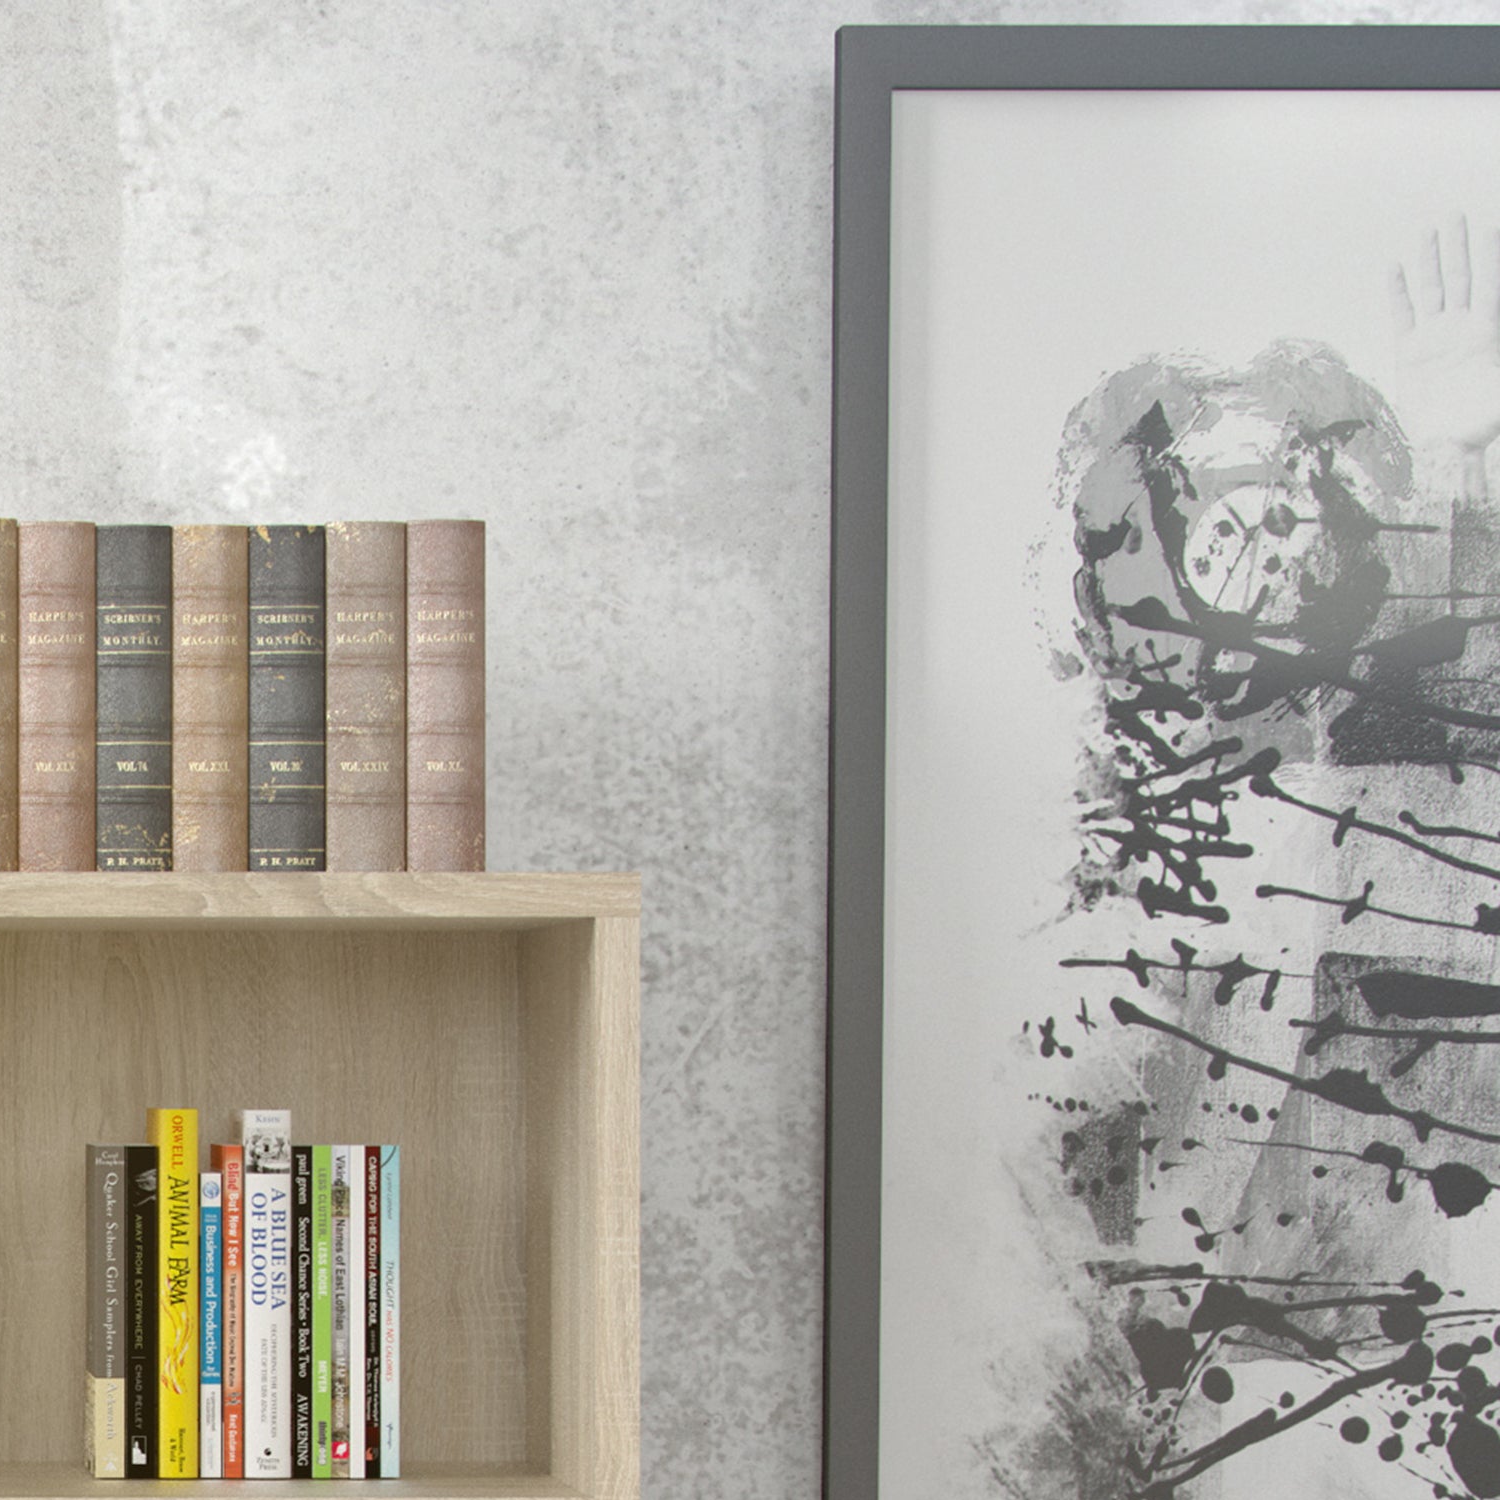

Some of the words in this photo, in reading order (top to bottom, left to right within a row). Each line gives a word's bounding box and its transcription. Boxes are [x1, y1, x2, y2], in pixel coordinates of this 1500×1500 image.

[28, 611, 85, 623] HARPER'S
[103, 613, 162, 625] SCRIBNER'S
[182, 613, 237, 625] HARPER'S
[257, 613, 315, 625] SCRIBNER'S
[336, 611, 394, 623] HARPER'S
[417, 610, 475, 622] HARPER'S
[28, 633, 85, 645] MAGAZINE
[181, 635, 238, 646] MAGAZINE
[336, 633, 395, 645] MAGAZINE
[417, 632, 476, 644] MAGAZINE
[171, 1115, 184, 1169] ORWELL
[227, 1162, 239, 1190] Blind
[296, 1154, 310, 1175] paul
[318, 1167, 327, 1191] LESS
[334, 1154, 346, 1187] Viking
[367, 1156, 377, 1192] CARING
[103, 1172, 119, 1217] Quaker
[227, 1192, 239, 1212] But
[271, 1187, 287, 1203] A
[295, 1177, 308, 1205] green
[335, 1188, 346, 1217] Place
[367, 1194, 377, 1214] FOR
[168, 1175, 191, 1249] ANIMAL
[251, 1192, 268, 1222] OF
[134, 1214, 143, 1243] AWAY
[227, 1215, 239, 1237] Now
[271, 1209, 287, 1267] BLUE
[298, 1217, 310, 1252] Second
[335, 1219, 346, 1253] Names
[367, 1215, 377, 1235] THE
[106, 1222, 119, 1261] School
[205, 1225, 217, 1272] Business
[317, 1241, 328, 1265] LESS
[367, 1237, 377, 1270] SOUTH
[134, 1245, 143, 1274] FROM
[227, 1247, 239, 1267] See
[251, 1227, 268, 1305] BLOOD
[298, 1253, 310, 1290] Chance
[335, 1254, 346, 1266] of
[106, 1266, 119, 1293] Girl
[168, 1257, 191, 1306] FARM
[205, 1276, 217, 1298] and
[271, 1271, 287, 1310] SEA
[335, 1268, 346, 1291] East
[367, 1271, 377, 1300] ASIAN
[386, 1260, 395, 1309] THOUGHT
[134, 1279, 143, 1350] EVERYWHERE
[298, 1291, 310, 1321] Series
[335, 1293, 346, 1331] Lothian
[103, 1298, 119, 1351] Samplers
[205, 1301, 217, 1363] Production
[386, 1328, 395, 1343] NO
[299, 1328, 310, 1353] Book
[106, 1355, 116, 1379] from
[134, 1364, 143, 1393] CHAD
[299, 1354, 310, 1378] Two
[317, 1359, 328, 1393] MEYER
[106, 1382, 119, 1440] Ackworth
[134, 1395, 143, 1429] PELLEY
[297, 1394, 309, 1467] AWAKENING
